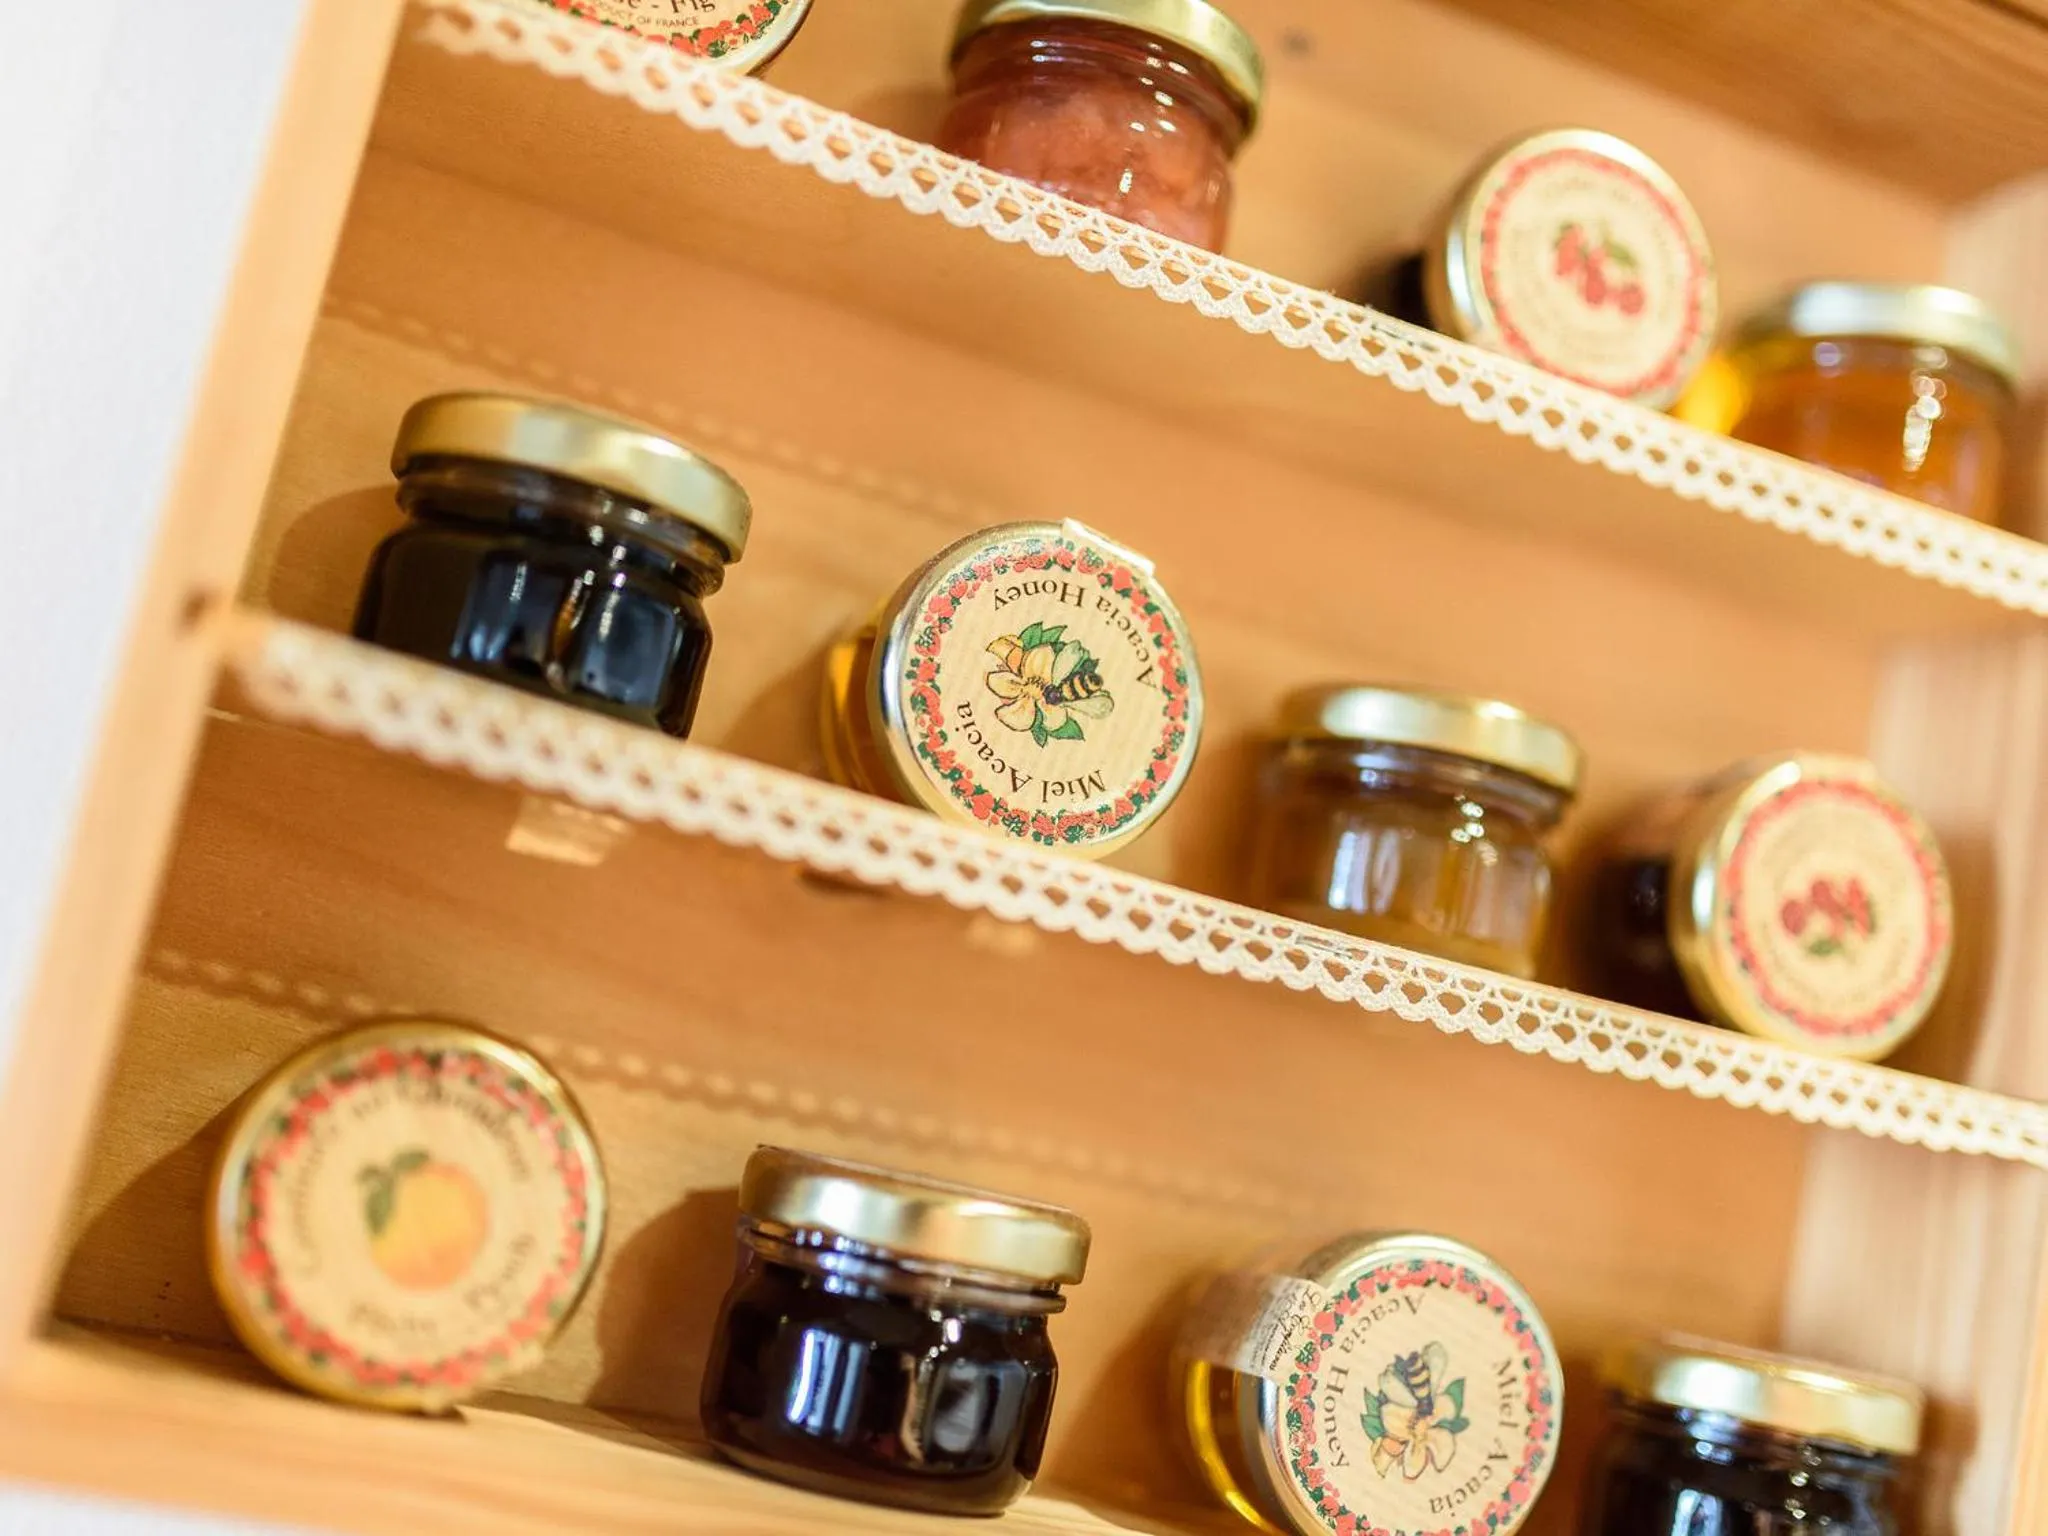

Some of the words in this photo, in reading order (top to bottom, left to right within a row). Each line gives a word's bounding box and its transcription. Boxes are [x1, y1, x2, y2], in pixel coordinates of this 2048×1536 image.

[636, 15, 652, 25] OF
[655, 16, 698, 28] FRANCE
[993, 579, 1086, 611] Honey
[1096, 595, 1158, 689] Acacia
[955, 701, 1033, 792] Acacia
[1042, 769, 1106, 803] Miel
[1339, 1292, 1426, 1353] Acacia
[1323, 1365, 1350, 1468] Honey
[1492, 1358, 1519, 1428] Miel
[1429, 1437, 1508, 1517] Acacia
